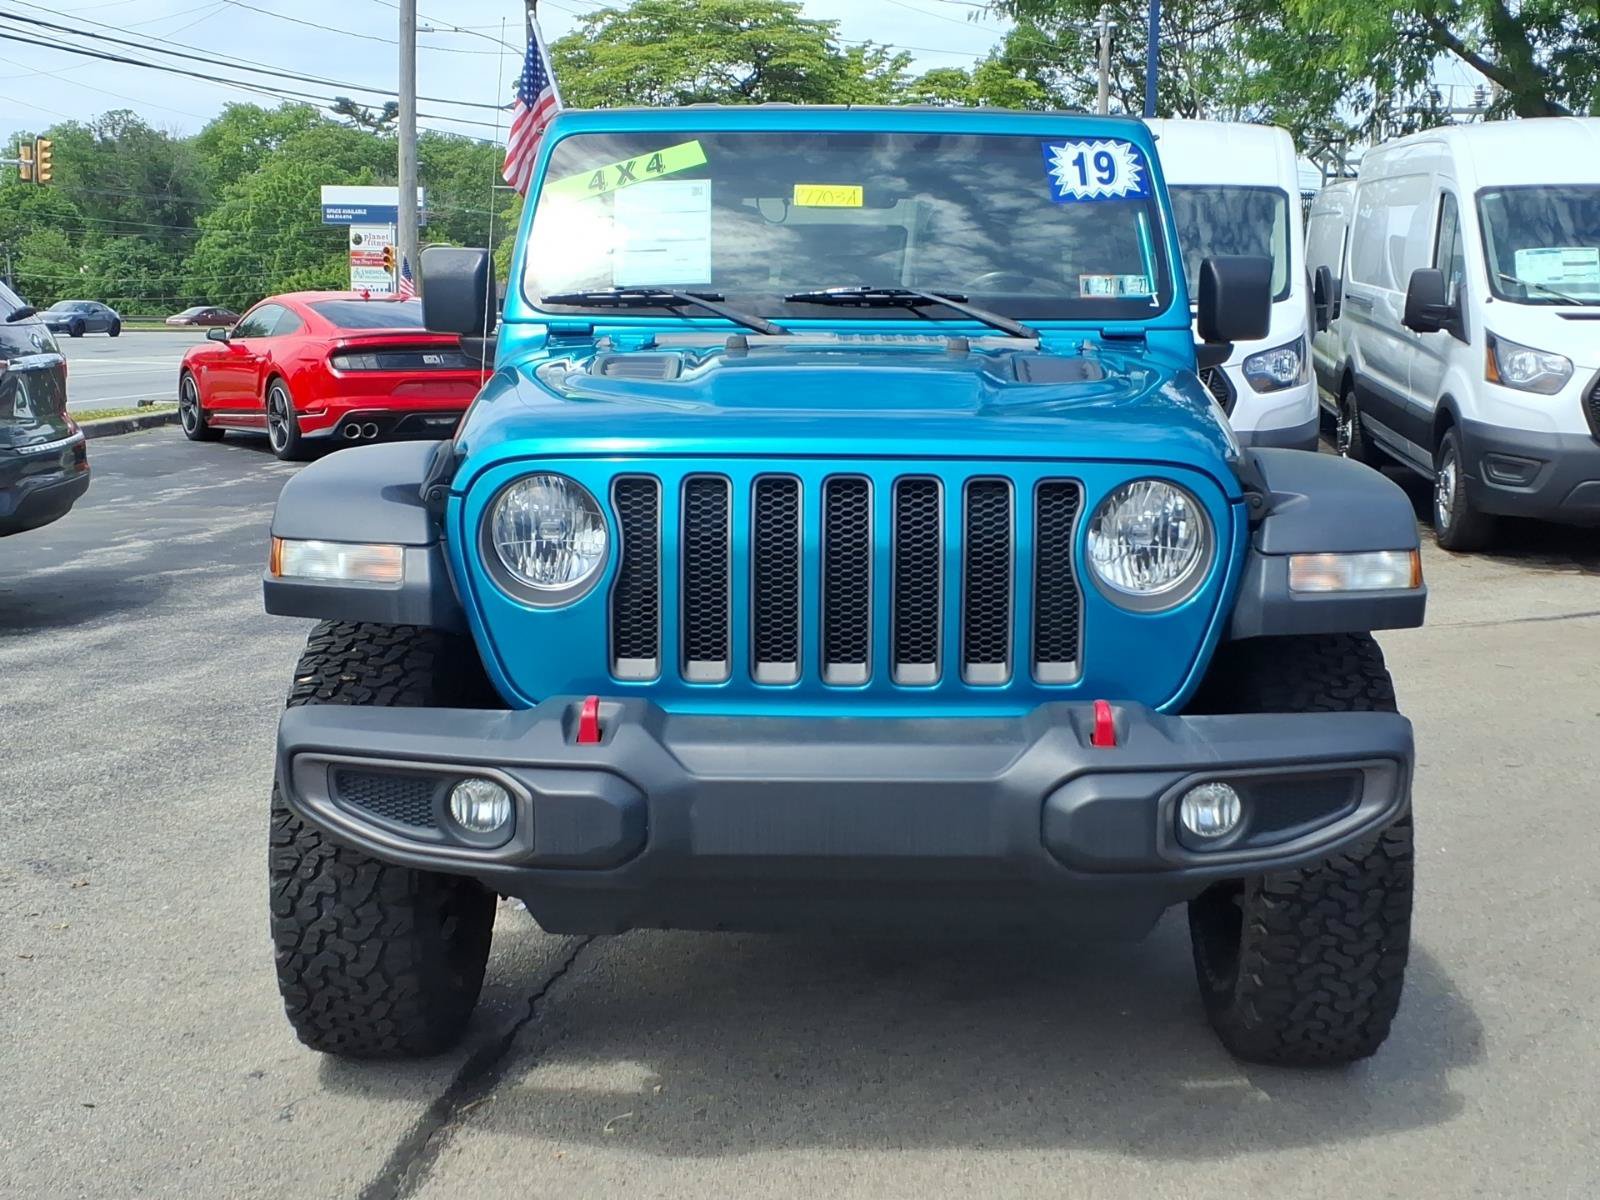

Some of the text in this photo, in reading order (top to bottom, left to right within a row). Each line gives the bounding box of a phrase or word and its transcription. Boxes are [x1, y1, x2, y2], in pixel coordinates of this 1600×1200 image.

[588, 170, 607, 191] 4
[646, 153, 666, 173] 4
[1072, 151, 1117, 187] 19
[364, 233, 389, 241] planet
